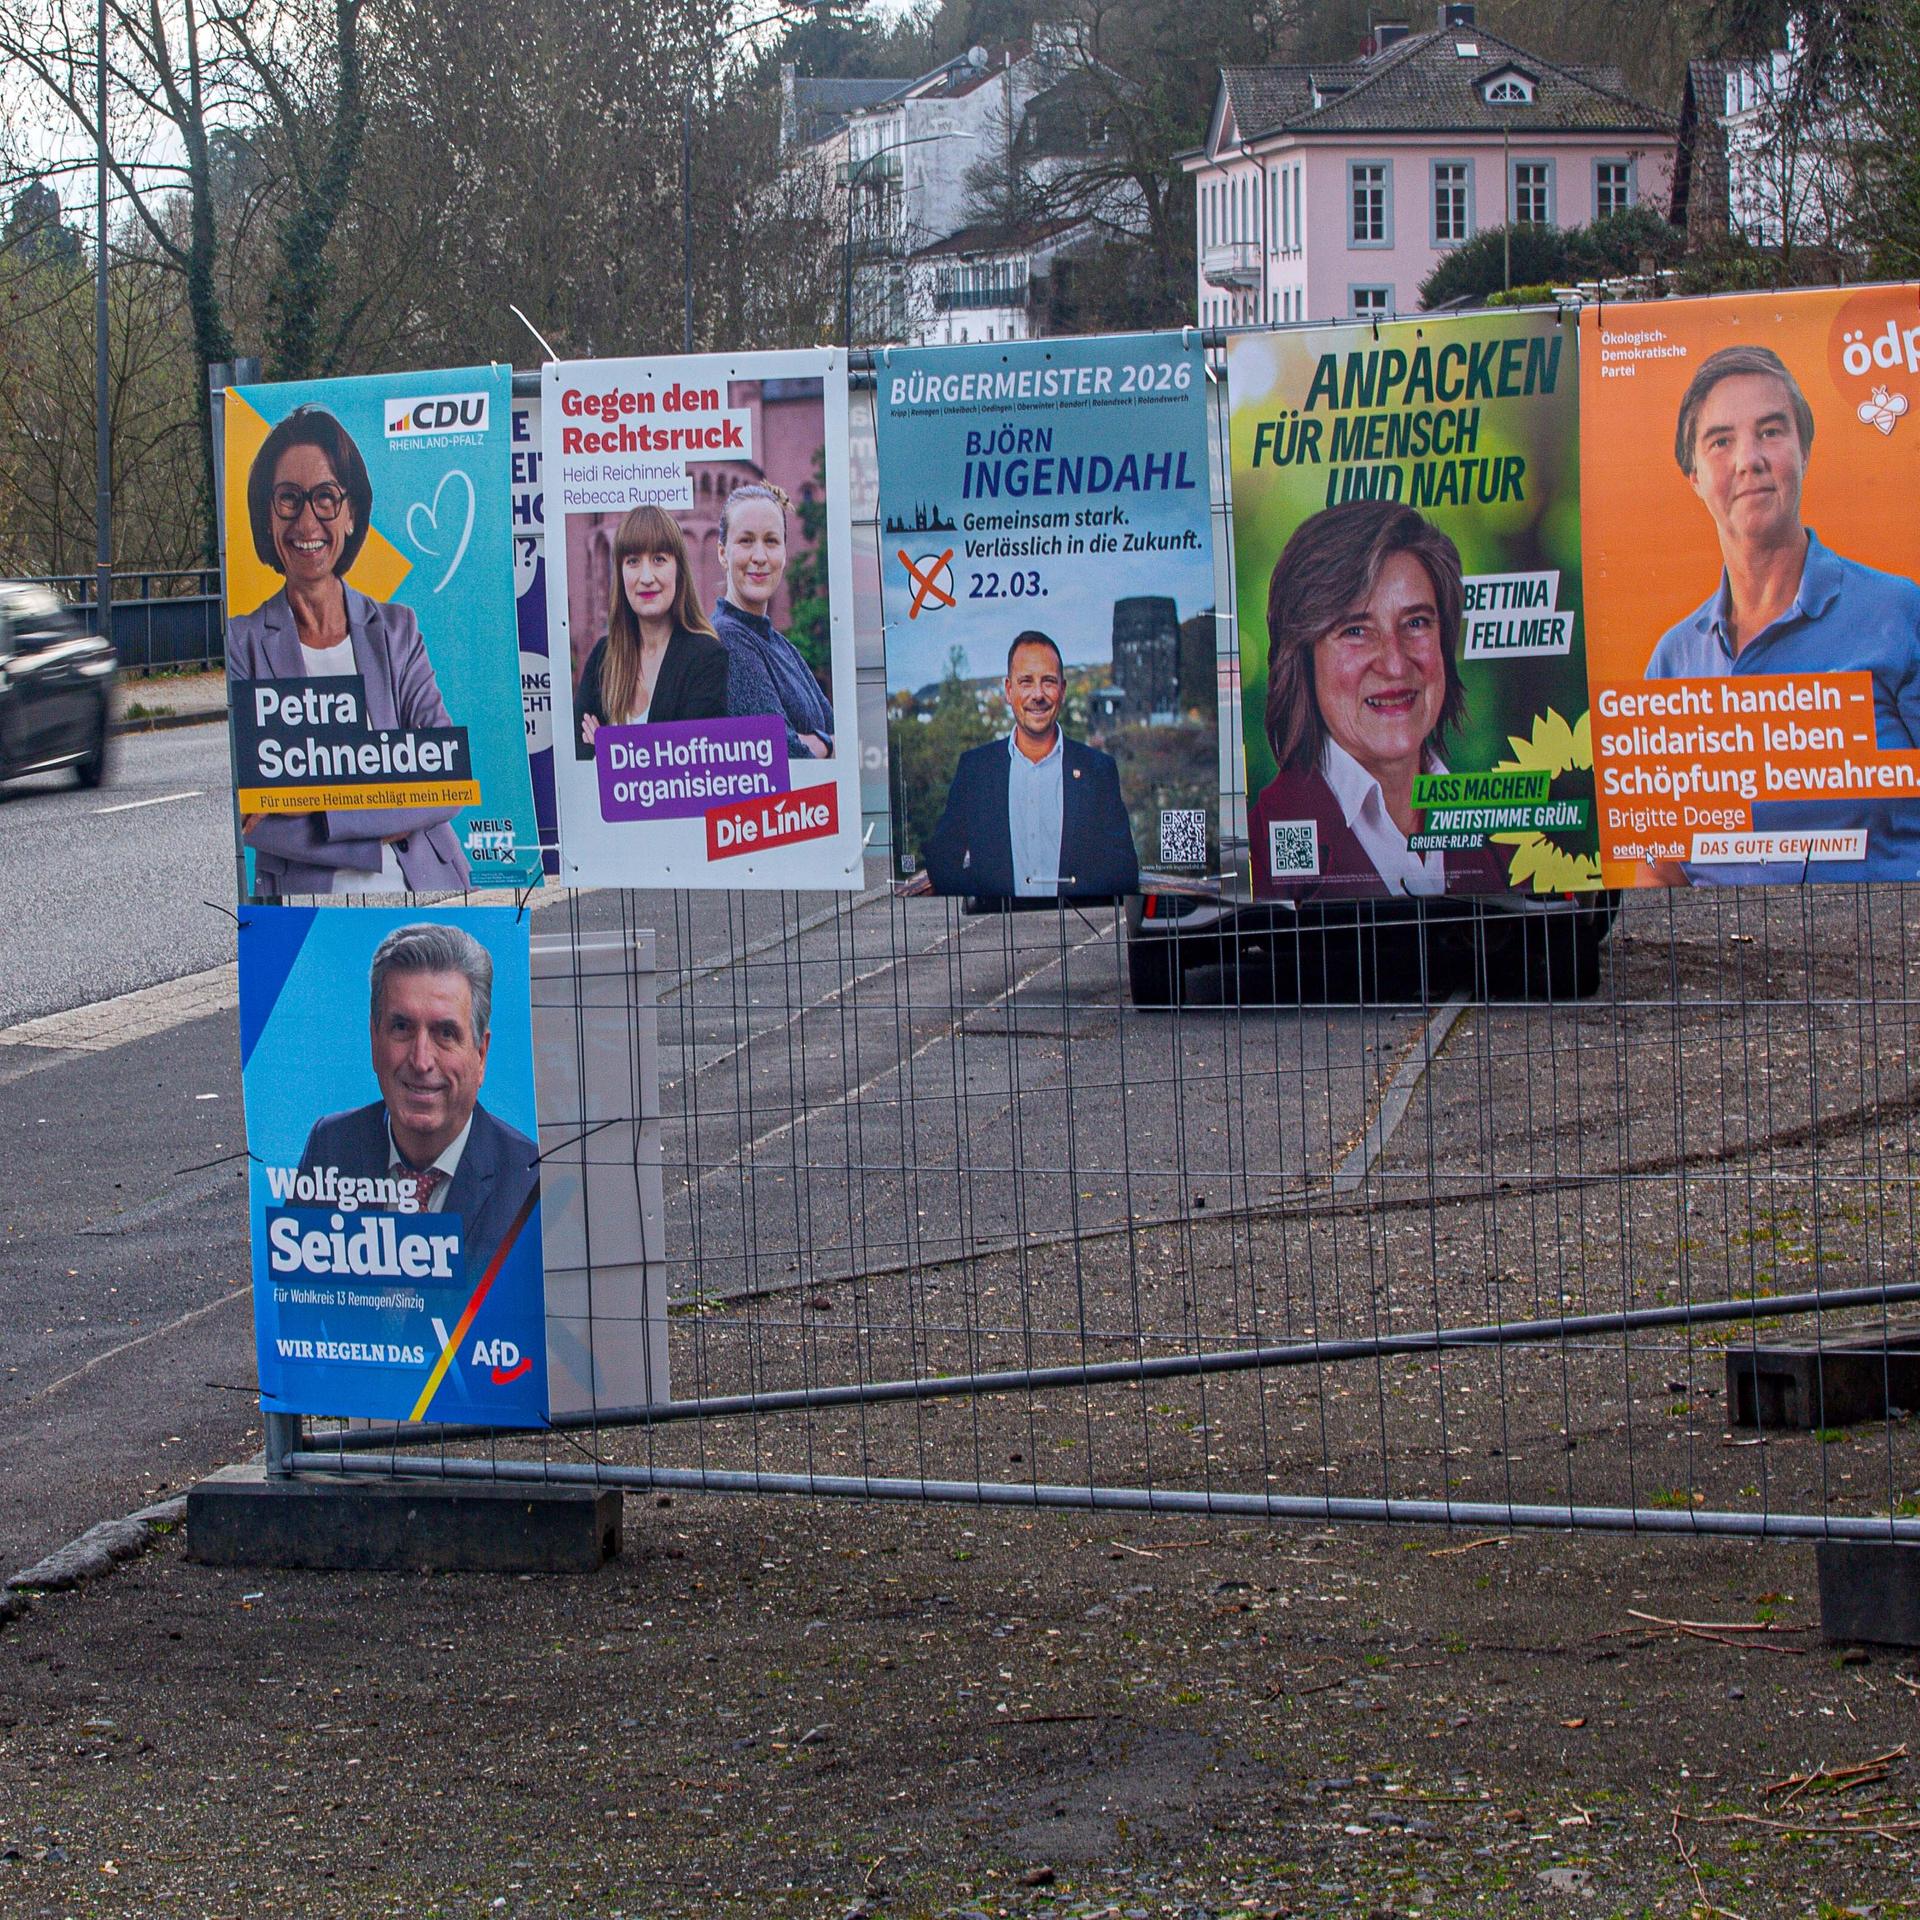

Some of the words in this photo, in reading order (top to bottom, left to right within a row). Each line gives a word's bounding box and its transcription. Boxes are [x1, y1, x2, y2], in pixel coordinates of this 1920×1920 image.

[1601, 330, 1668, 346] Ökologisch-
[1601, 345, 1687, 362] Demokratische
[1843, 320, 1920, 376] ödp
[890, 365, 1113, 405] BÜRGERMEISTER
[1119, 362, 1192, 393] 2026
[1303, 335, 1563, 412] ANPACKEN
[1601, 365, 1636, 378] Partei
[412, 398, 485, 429] CDU
[561, 387, 655, 423] Gegen
[662, 383, 719, 412] den
[389, 434, 484, 451] RHEINLAND-PFALZ
[562, 419, 744, 454] Rechtsruck
[965, 422, 1053, 456] BJÖRN
[1252, 410, 1323, 468] FÜR
[1329, 407, 1481, 464] MENSCH
[563, 466, 598, 482] Heidi
[602, 462, 681, 481] Reichinnek
[962, 451, 1196, 499] INGENDAHL
[1325, 464, 1404, 509] UND
[1409, 456, 1526, 508] NATUR
[563, 487, 625, 504] Rebecca
[629, 486, 688, 506] Ruppert
[963, 509, 1069, 531] Gemeinsam
[1075, 505, 1130, 527] stark.
[965, 534, 1064, 558] Verlässlich
[1068, 534, 1084, 554] in
[1089, 533, 1118, 553] die
[1122, 530, 1202, 551] Zukunft.
[969, 571, 1049, 599] 22.03.
[1464, 579, 1549, 611] BETTINA
[1471, 617, 1566, 650] FELLMER
[255, 687, 357, 727] Petra
[1598, 686, 1714, 718] Gerecht
[1721, 681, 1841, 713] handeln
[609, 743, 650, 769] Die
[654, 737, 773, 767] Hoffnung
[1601, 723, 1754, 757] solidarisch
[1762, 721, 1844, 751] leben
[258, 732, 458, 778] Schneider
[613, 769, 777, 807] organisieren.
[1417, 777, 1460, 803] LASS
[1463, 776, 1543, 801] MACHEN!
[1602, 762, 1758, 801] Schöpfung
[1764, 759, 1920, 790] bewahren.
[260, 795, 279, 808] Für
[282, 796, 321, 807] unsere
[323, 792, 364, 805] Heimat
[366, 790, 406, 806] schlägt
[409, 790, 439, 802] mein
[441, 788, 473, 802] Herz!
[470, 819, 512, 832] WEIL'S
[716, 814, 758, 849] Die
[762, 800, 829, 838] Linke
[1430, 808, 1531, 831] ZWEITSTIMME
[1534, 802, 1582, 827] GRÜN.
[1608, 806, 1677, 832] Brigitte
[1684, 806, 1745, 831] Doege
[464, 832, 516, 849] JETZT
[472, 848, 499, 860] GILT
[1700, 841, 1728, 856] DAS
[1735, 839, 1774, 855] GUTE
[1779, 837, 1858, 854] GEWINNT!
[266, 1166, 420, 1213] Wolfgang
[270, 1214, 459, 1277] Seidler
[273, 1288, 289, 1303] Für
[291, 1289, 334, 1305] Wahlkreis
[337, 1291, 346, 1305] 13
[348, 1291, 425, 1312] Remagen/Sinzig
[276, 1339, 312, 1358] WIR
[316, 1342, 386, 1361] REGELN
[388, 1345, 425, 1364] DAS
[471, 1339, 520, 1367] AfD
